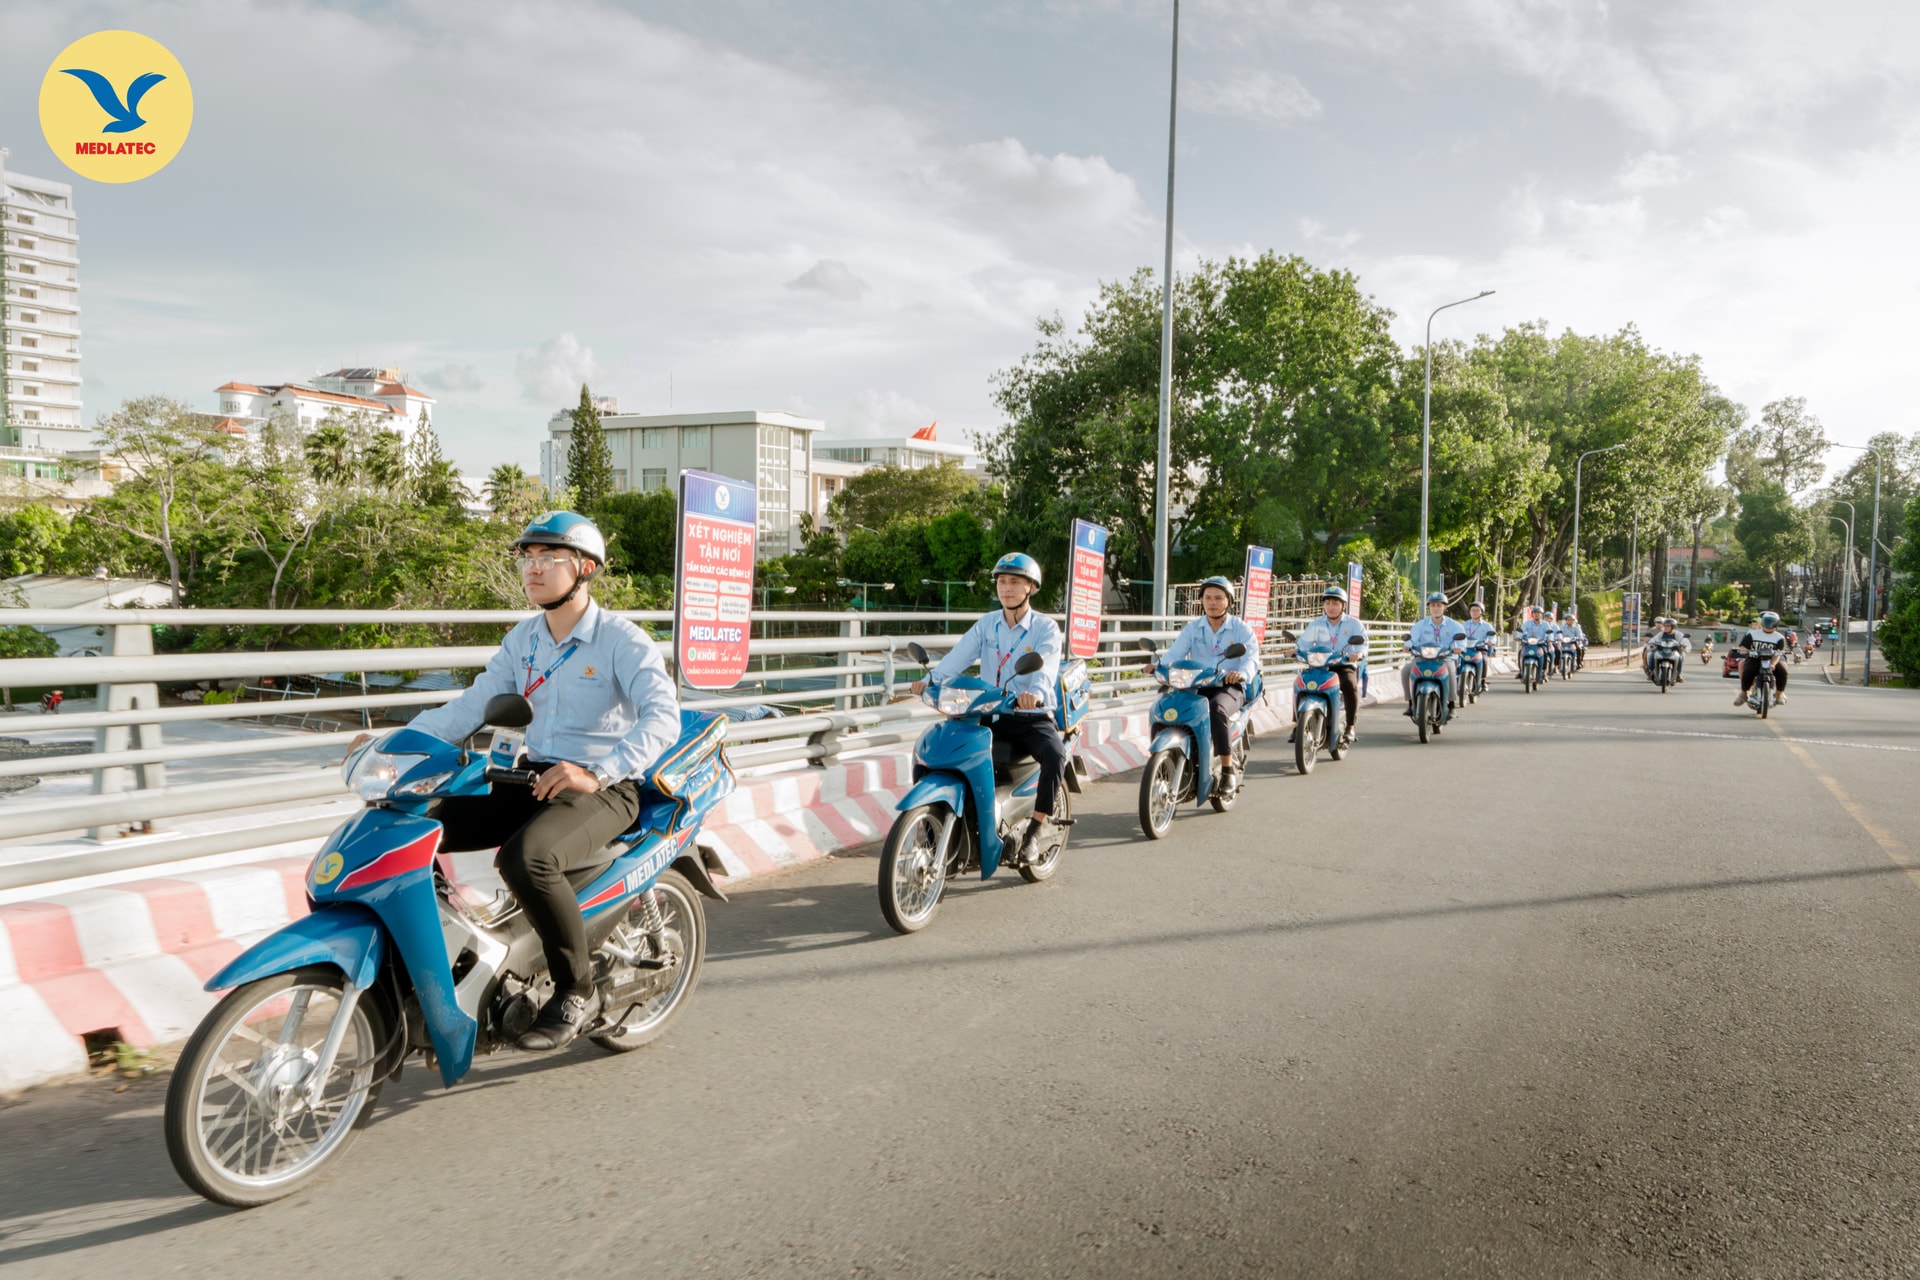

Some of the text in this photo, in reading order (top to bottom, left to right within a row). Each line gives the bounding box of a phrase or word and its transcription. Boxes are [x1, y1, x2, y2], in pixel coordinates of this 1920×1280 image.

[688, 521, 752, 548] XÉT NGHIỆM
[699, 542, 741, 562] TẬN NƠI
[700, 563, 715, 574] SOÁT
[716, 565, 729, 576] CÁC
[729, 567, 744, 579] BỆNH
[744, 569, 752, 578] LÝ
[689, 625, 742, 642] MEDLATEC
[626, 837, 678, 893] MEDLATEC
